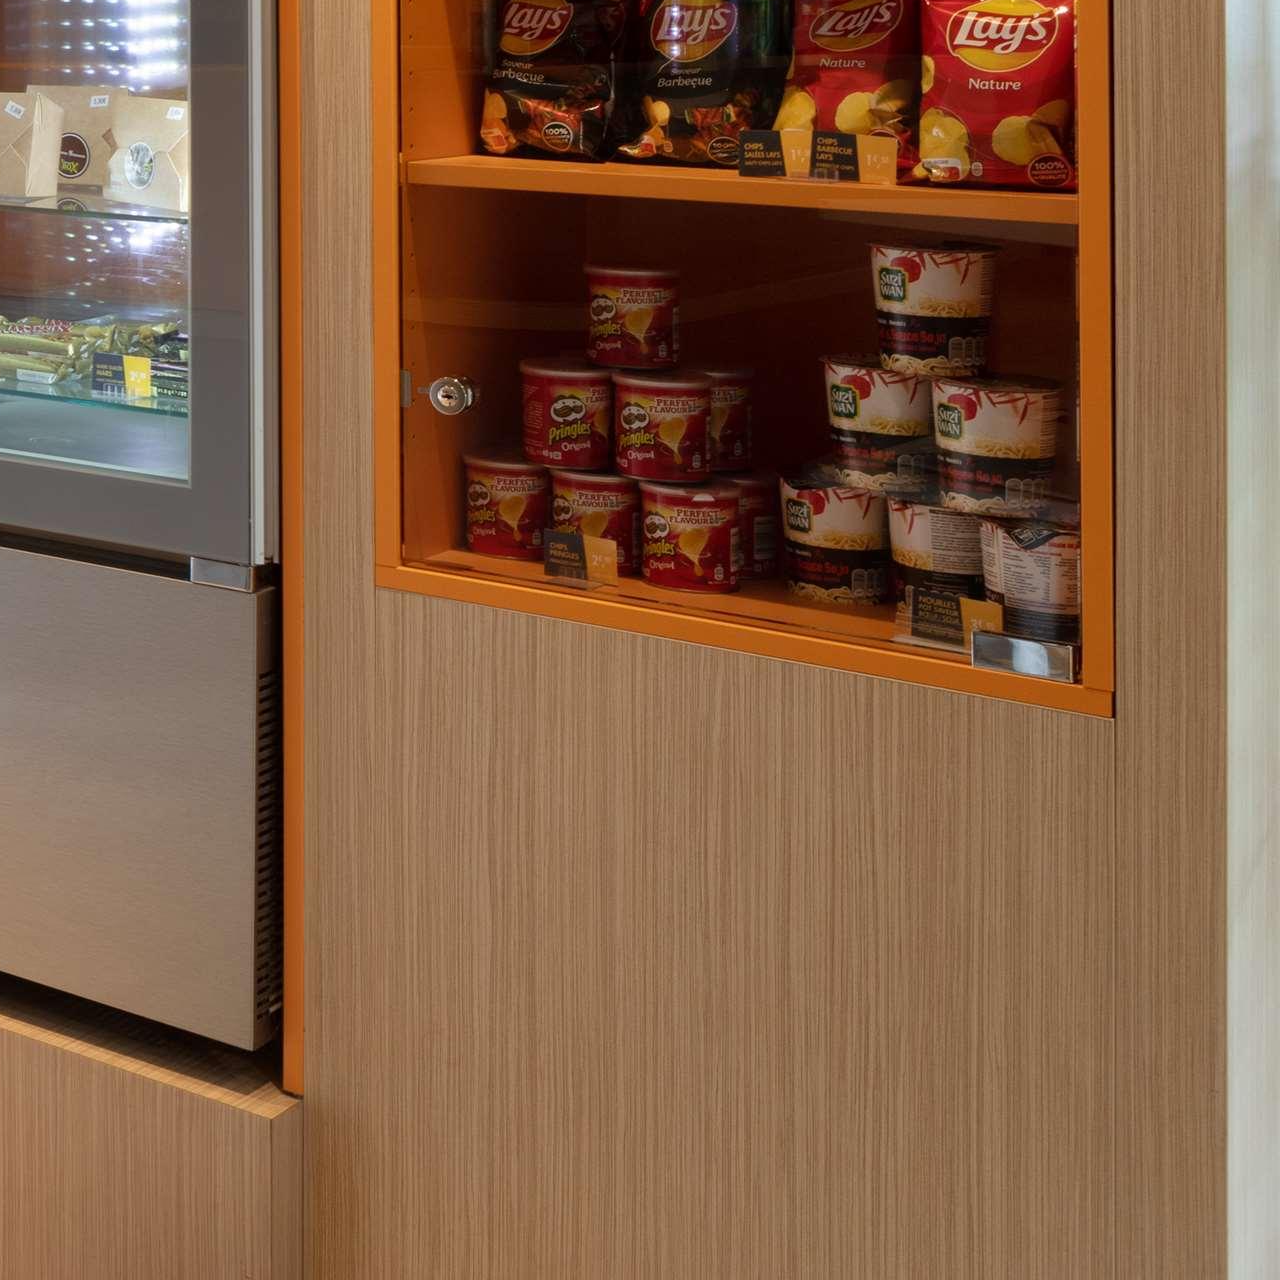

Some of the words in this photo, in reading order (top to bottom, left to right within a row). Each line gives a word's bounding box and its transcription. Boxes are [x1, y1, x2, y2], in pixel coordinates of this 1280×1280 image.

[503, 2, 569, 41] Lay's
[655, 3, 732, 46] Lay's
[814, 0, 897, 39] Lay's
[953, 11, 1052, 55] Lay's
[819, 57, 867, 69] Nature
[968, 77, 1023, 91] Nature
[743, 142, 765, 151] CHIPS
[817, 136, 839, 146] CHIPS
[766, 151, 782, 160] LAYS
[816, 144, 853, 156] BARBECUE
[816, 152, 834, 161] LAYS
[880, 270, 904, 287] Suzi
[880, 284, 904, 298] WAN
[655, 398, 697, 409] PERFECT
[831, 402, 855, 415] WAN
[938, 407, 960, 423] Suzi
[548, 421, 591, 444] Pringles
[937, 420, 961, 436] WAN
[495, 477, 536, 487] PERFECT
[577, 491, 620, 502] PERFECT
[676, 508, 720, 519] PERFECT
[788, 515, 809, 529] WAN
[919, 595, 957, 609] NOUILLES
